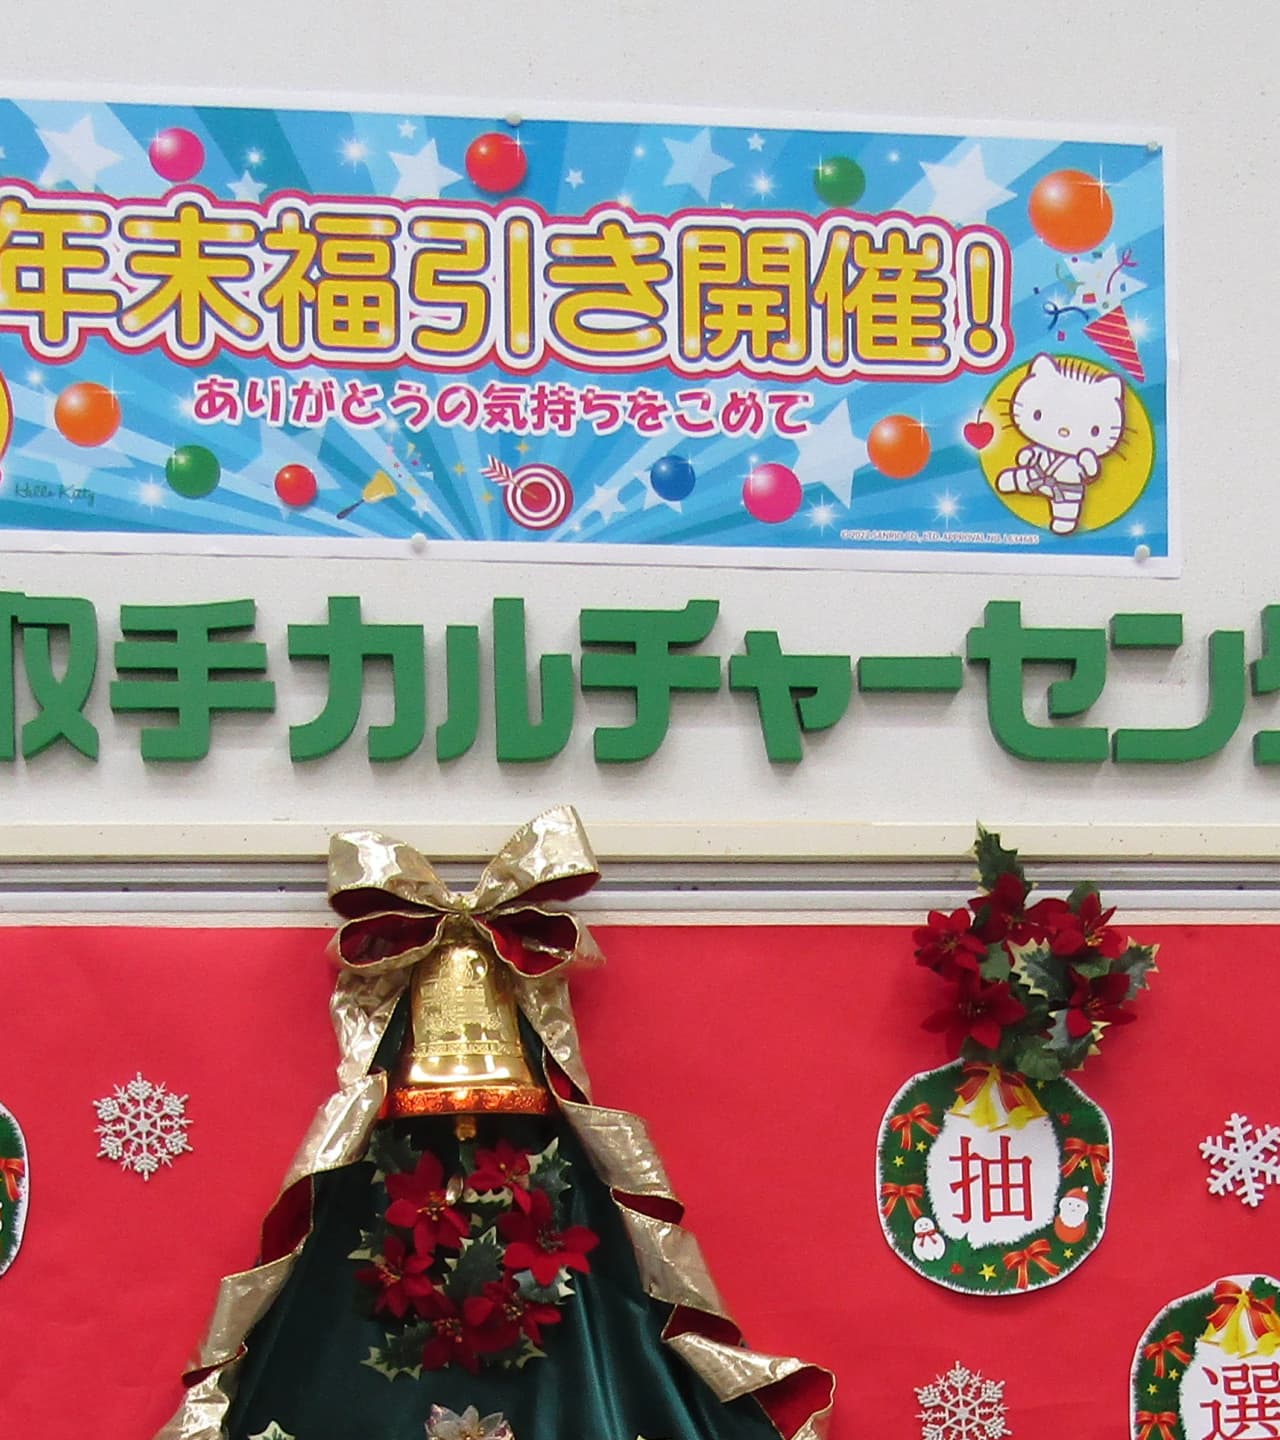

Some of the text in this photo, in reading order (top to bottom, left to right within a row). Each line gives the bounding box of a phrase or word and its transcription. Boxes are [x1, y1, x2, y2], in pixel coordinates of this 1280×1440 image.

[192, 376, 812, 436] ありがとうの気持ちをこめて
[949, 1135, 1034, 1223] 抽
